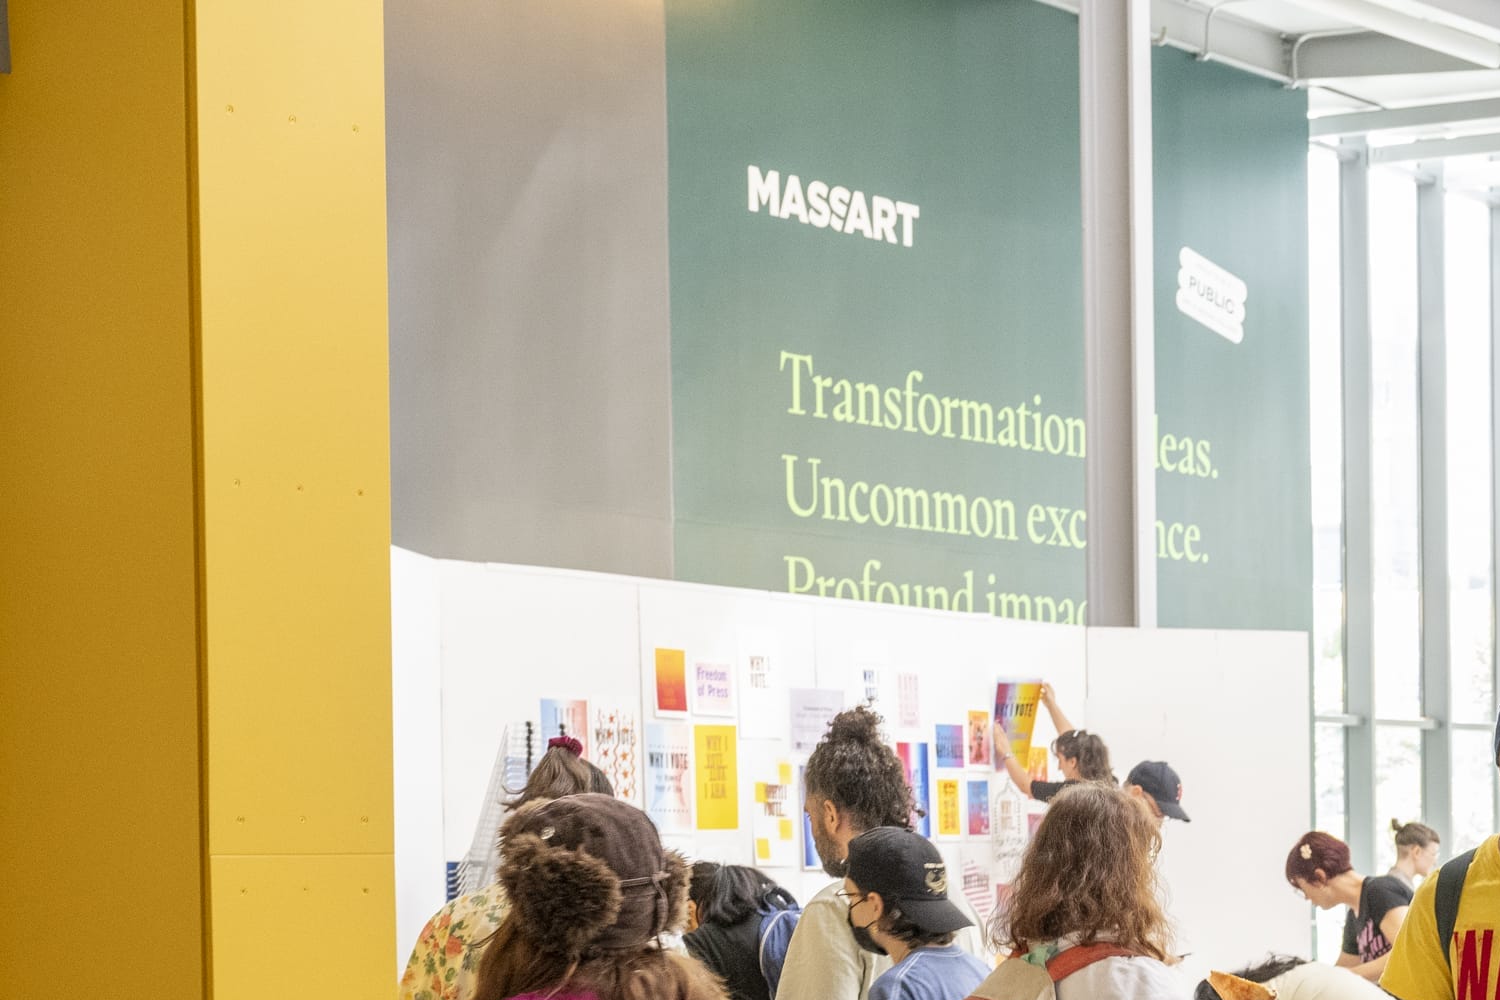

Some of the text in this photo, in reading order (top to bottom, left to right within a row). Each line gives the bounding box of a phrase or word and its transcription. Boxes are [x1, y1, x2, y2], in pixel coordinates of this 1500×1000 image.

[1188, 275, 1236, 315] PUBLIC
[780, 350, 1086, 458] Transformation
[781, 454, 1018, 541] Uncommon
[697, 666, 727, 682] Freedom
[708, 684, 728, 698] Press
[671, 753, 688, 770] VOTE
